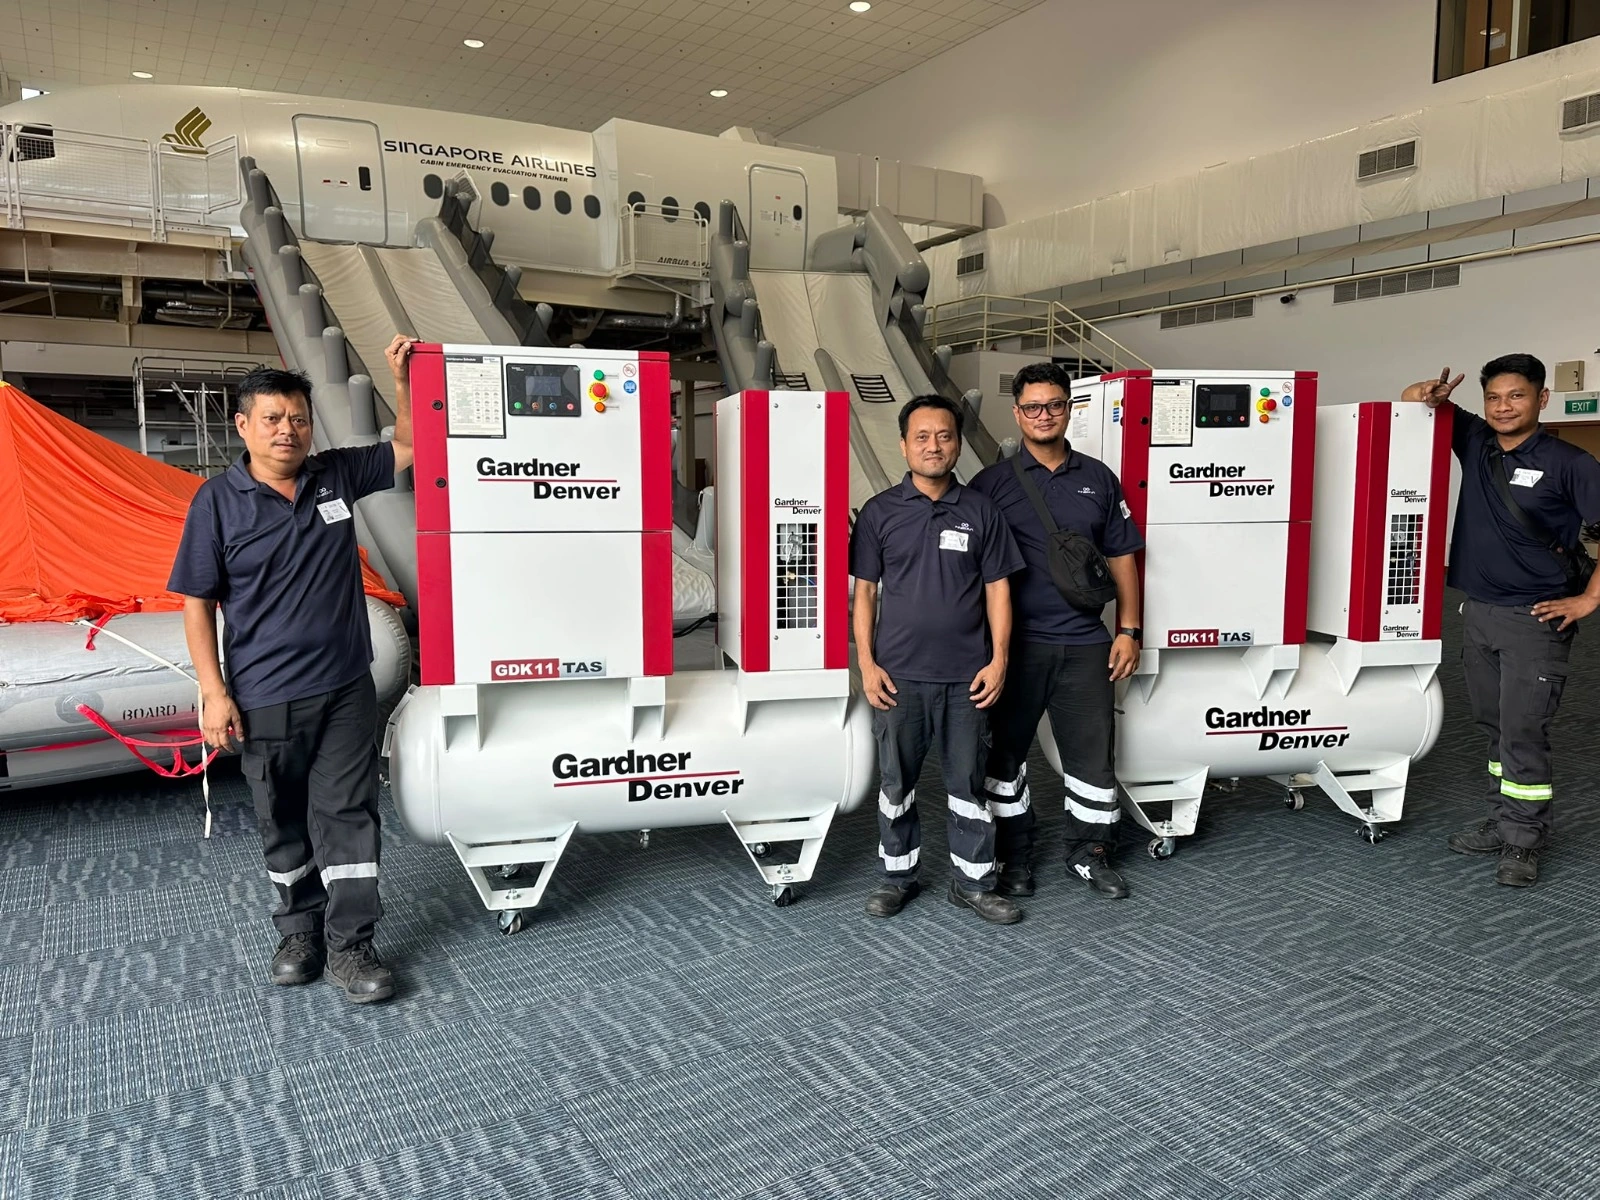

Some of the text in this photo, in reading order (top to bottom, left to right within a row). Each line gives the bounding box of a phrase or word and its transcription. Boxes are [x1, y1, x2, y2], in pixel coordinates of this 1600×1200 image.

[384, 140, 597, 178] SINGAPORE AIRLINES
[420, 159, 568, 183] CABIN EMERGENCY EVACUATION TRAINER
[1571, 401, 1590, 412] EXIT
[476, 457, 581, 477] Gardner
[1169, 463, 1246, 479] Gardner
[534, 481, 621, 499] Denver
[1209, 481, 1275, 497] Denver
[774, 498, 809, 506] Gardner
[792, 506, 822, 515] Denver
[1170, 632, 1251, 644] GDK11 TAS
[494, 661, 603, 677] GDK11 TAS
[122, 704, 177, 721] BOARD
[1205, 706, 1312, 730] Gardner
[1258, 731, 1351, 751] Denver
[552, 749, 692, 780] Gardner
[628, 779, 745, 802] Denver
